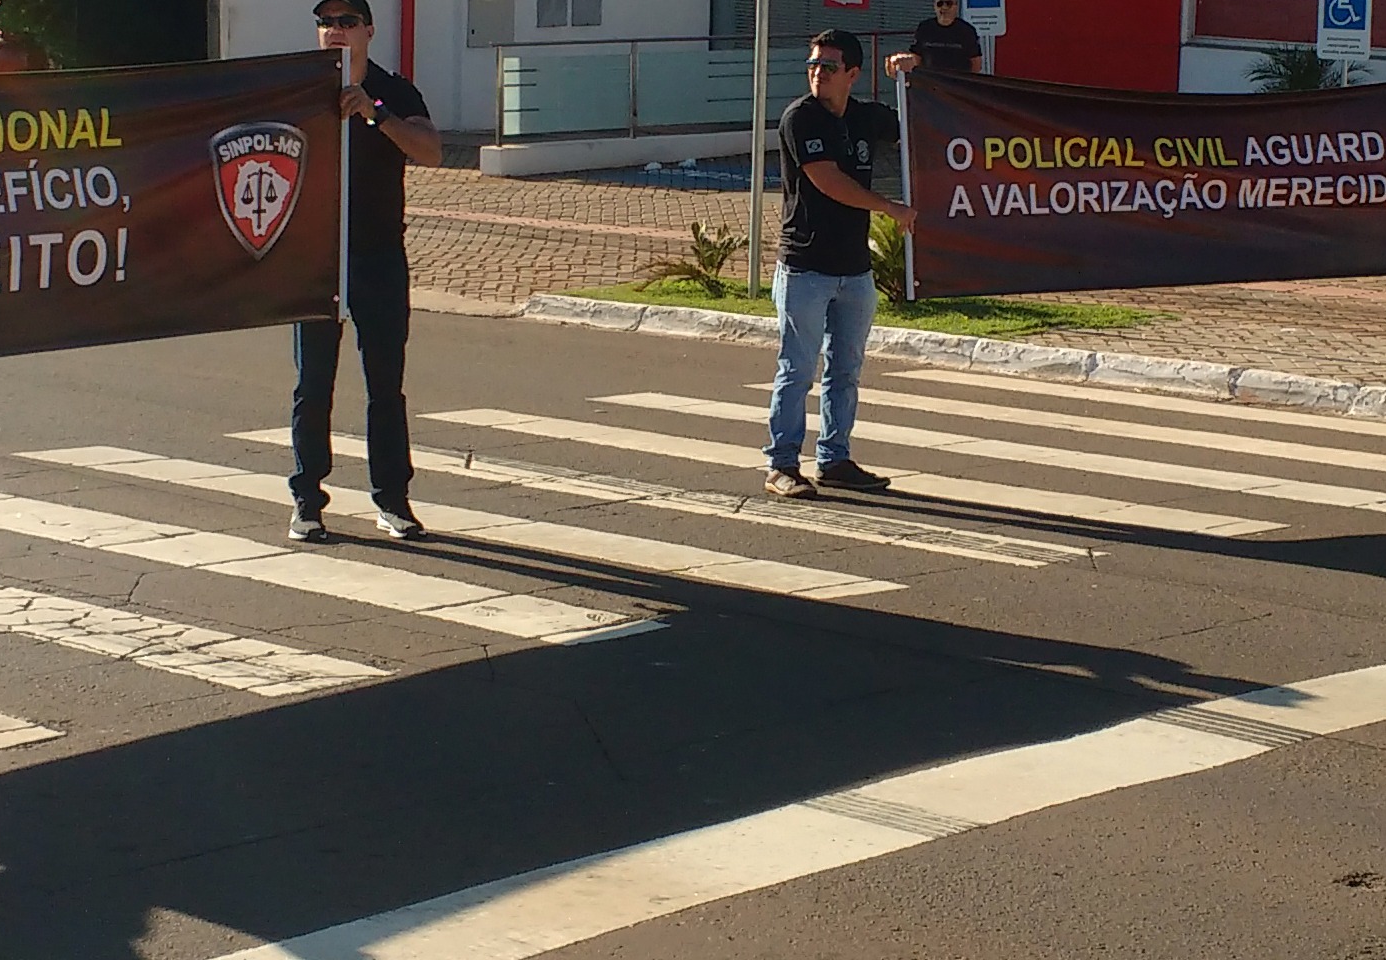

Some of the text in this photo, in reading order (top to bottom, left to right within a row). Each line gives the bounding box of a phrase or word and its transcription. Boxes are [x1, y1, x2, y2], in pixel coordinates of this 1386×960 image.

[218, 134, 302, 162] SINPOL-MS
[946, 137, 974, 171] O
[984, 136, 1146, 170] POLICIAL
[1154, 137, 1238, 168] CIVIL
[948, 185, 976, 218] A
[980, 172, 1228, 219] VALORIZAÇÃO
